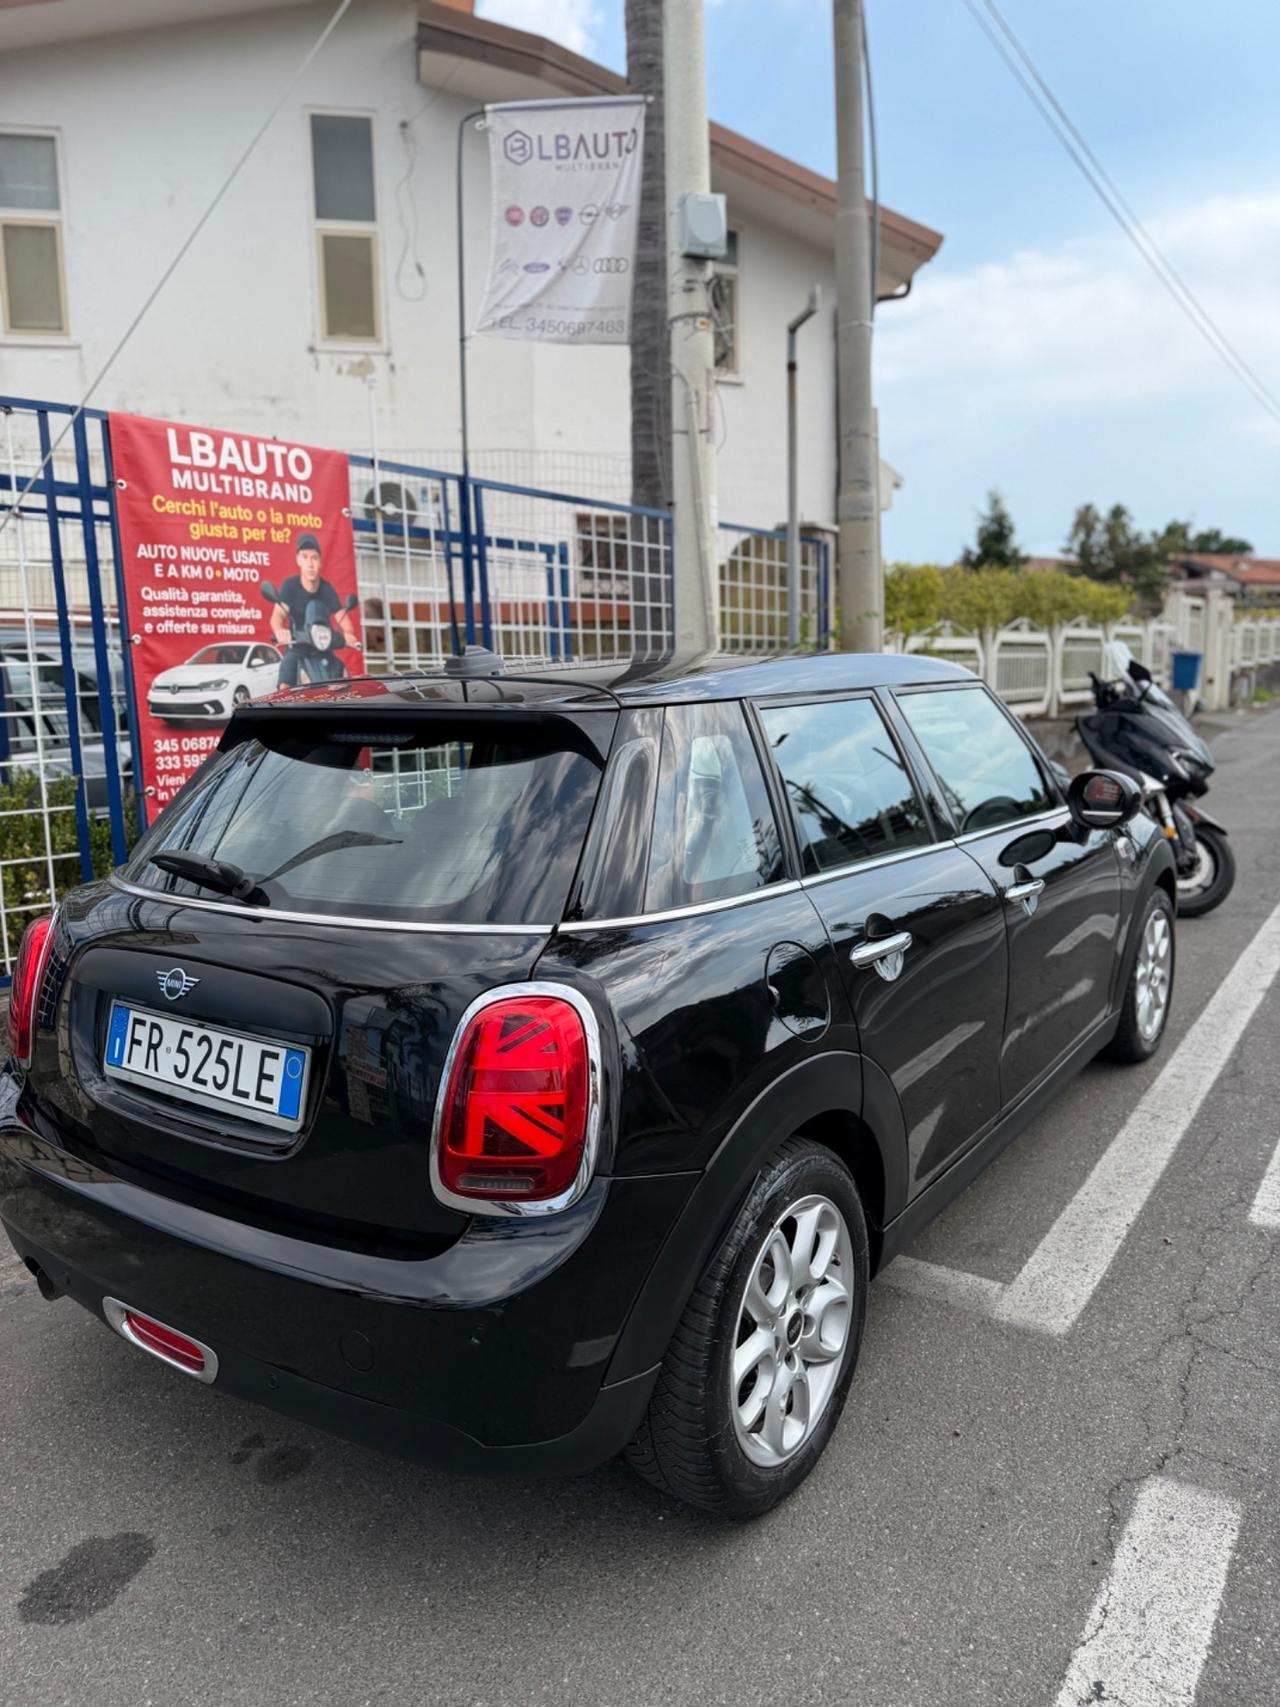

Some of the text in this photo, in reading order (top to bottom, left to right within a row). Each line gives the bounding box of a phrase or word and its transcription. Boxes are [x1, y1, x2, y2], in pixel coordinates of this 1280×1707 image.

[166, 427, 313, 481] LBAUTO
[171, 468, 313, 504] MULTIBRAND
[151, 494, 323, 529] Cerchi l'auto o la moto
[189, 519, 292, 544] giusta per te?
[136, 543, 271, 566] AUTO NUOVE, USATE
[153, 563, 165, 578] E
[167, 563, 180, 579] A
[181, 564, 203, 579] KM
[222, 567, 260, 582] MOTO
[140, 586, 247, 606] Qualità garantita,
[142, 603, 263, 621] assistenza completa
[143, 619, 256, 635] e offerte su misura
[153, 738, 180, 754] 345
[155, 754, 182, 770] 333
[127, 1017, 164, 1073] FR
[173, 1029, 281, 1106] 525LE
